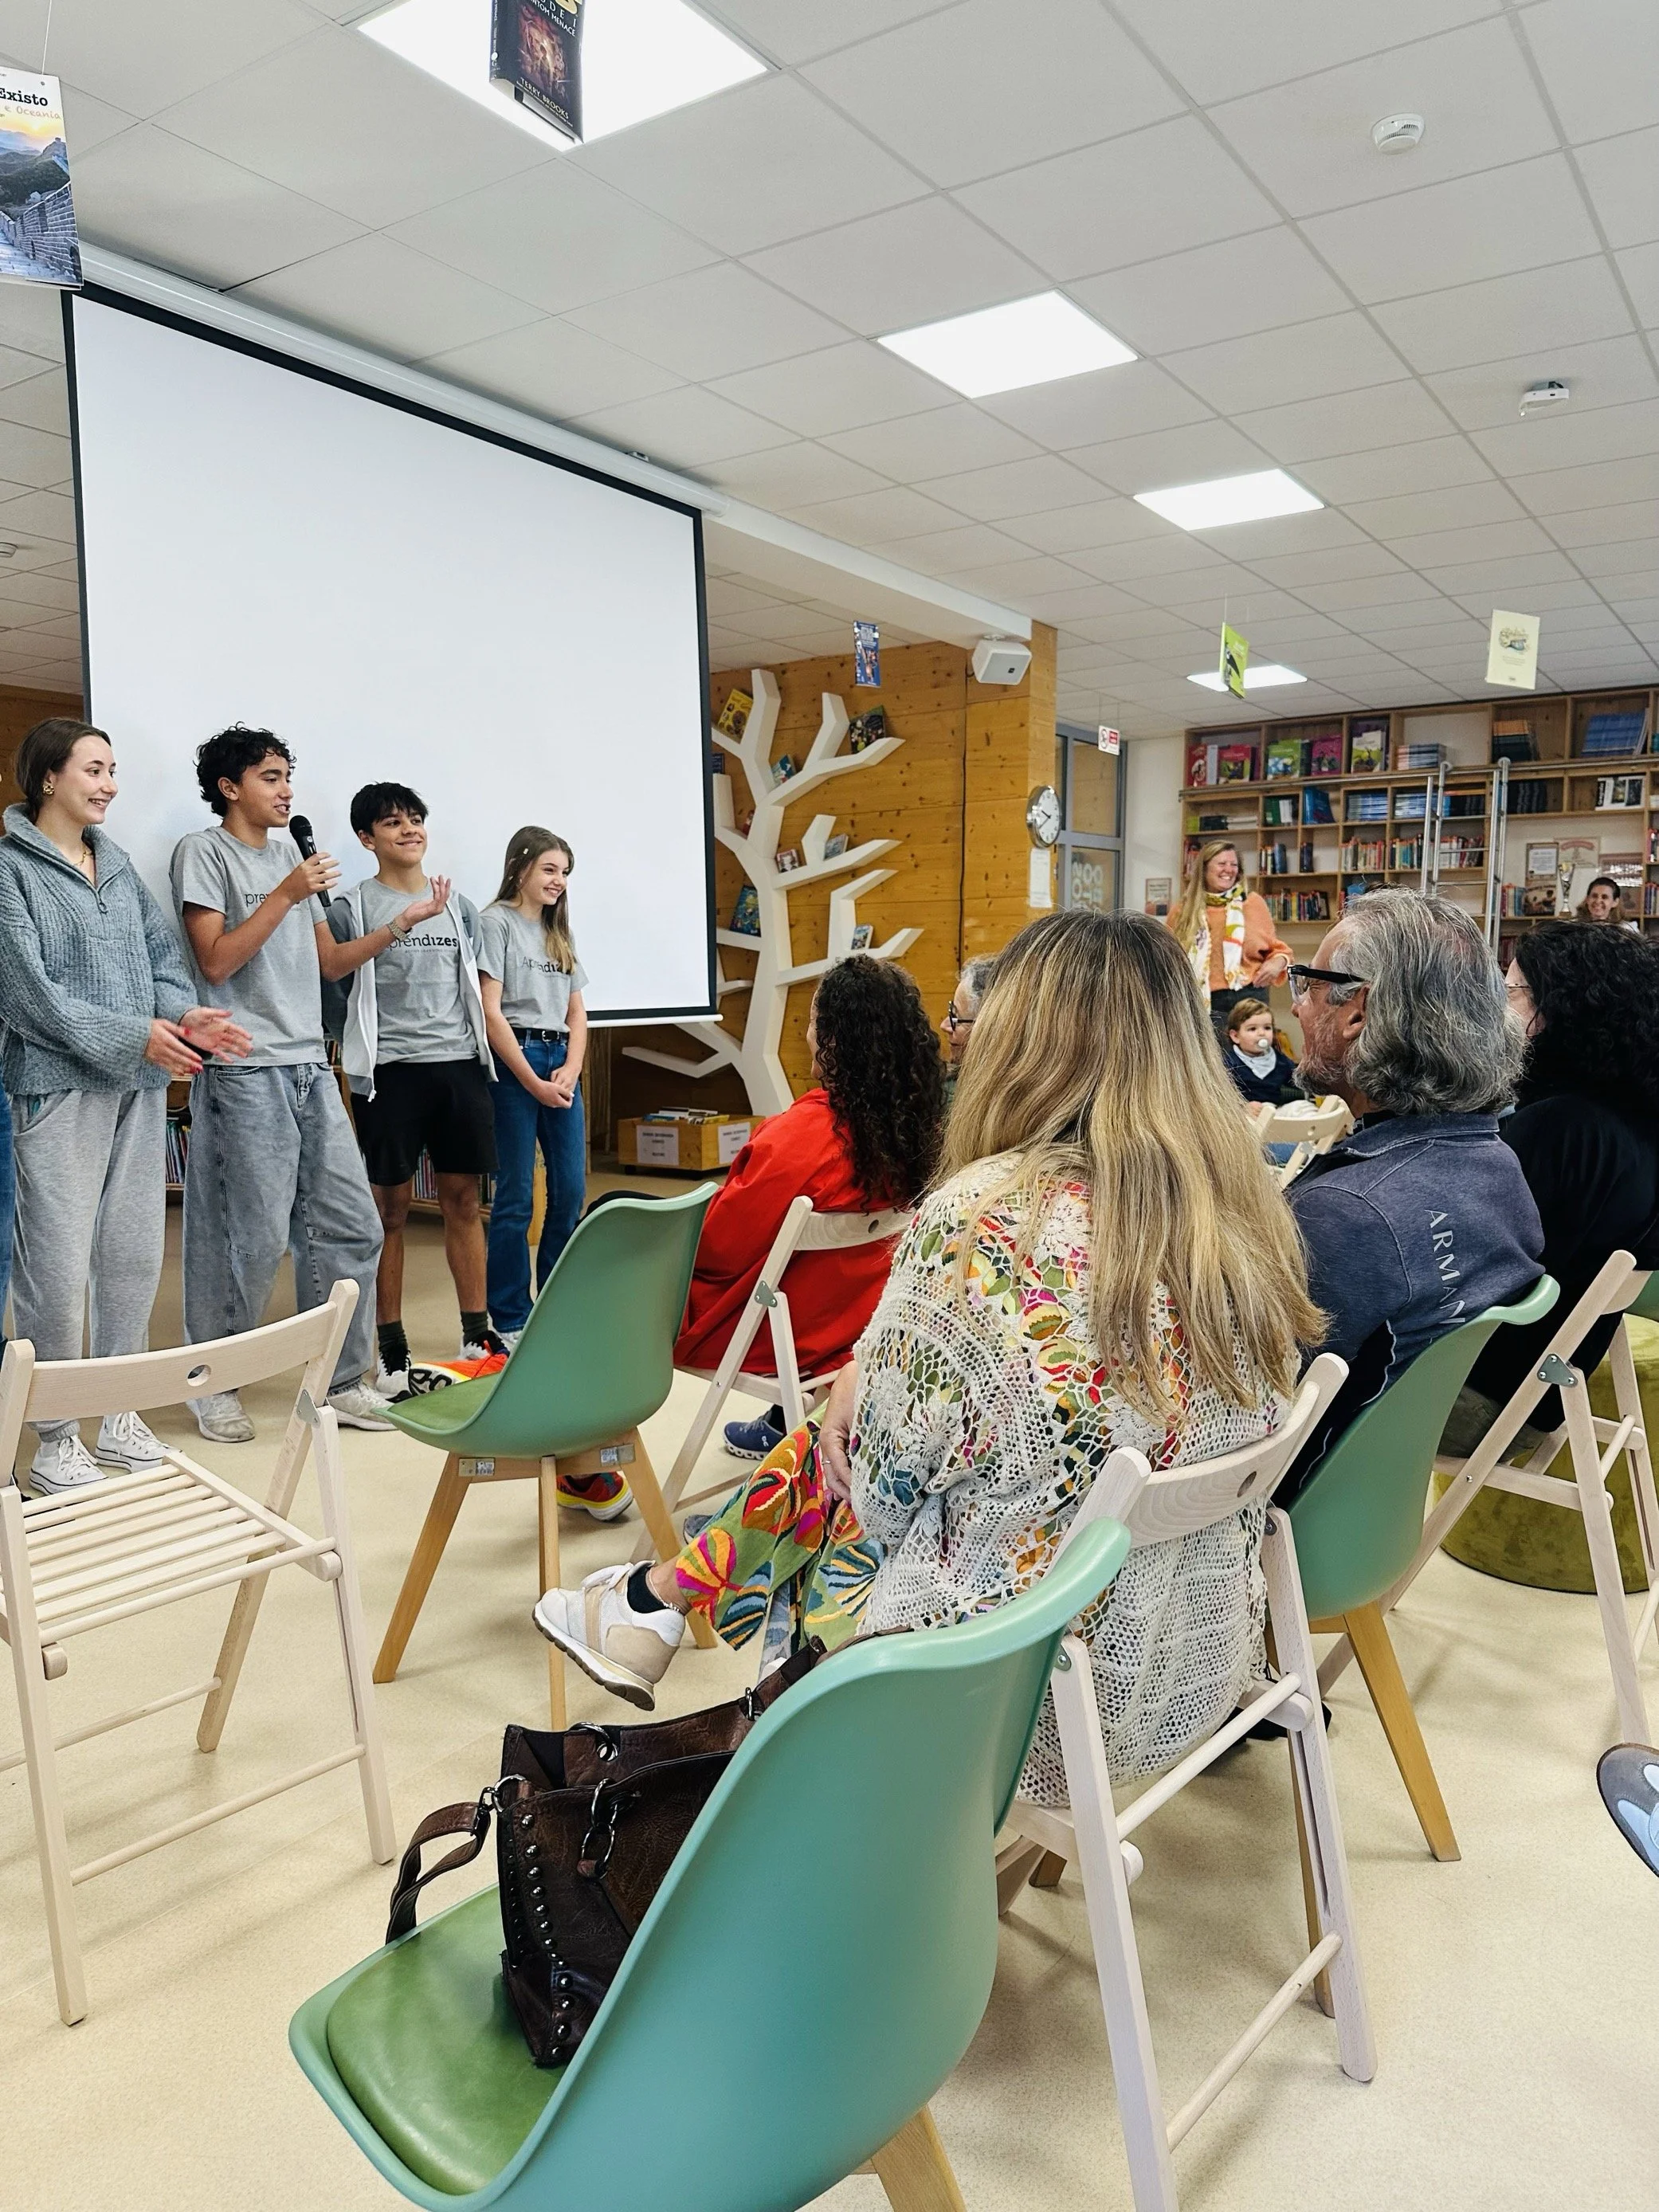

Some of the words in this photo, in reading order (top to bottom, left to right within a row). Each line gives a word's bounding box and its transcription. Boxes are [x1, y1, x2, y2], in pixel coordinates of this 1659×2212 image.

[551, 13, 575, 37] MENACE
[0, 88, 48, 106] Existo
[520, 77, 540, 96] TERRY
[543, 95, 569, 120] BROOKS
[16, 105, 62, 120] Oceania
